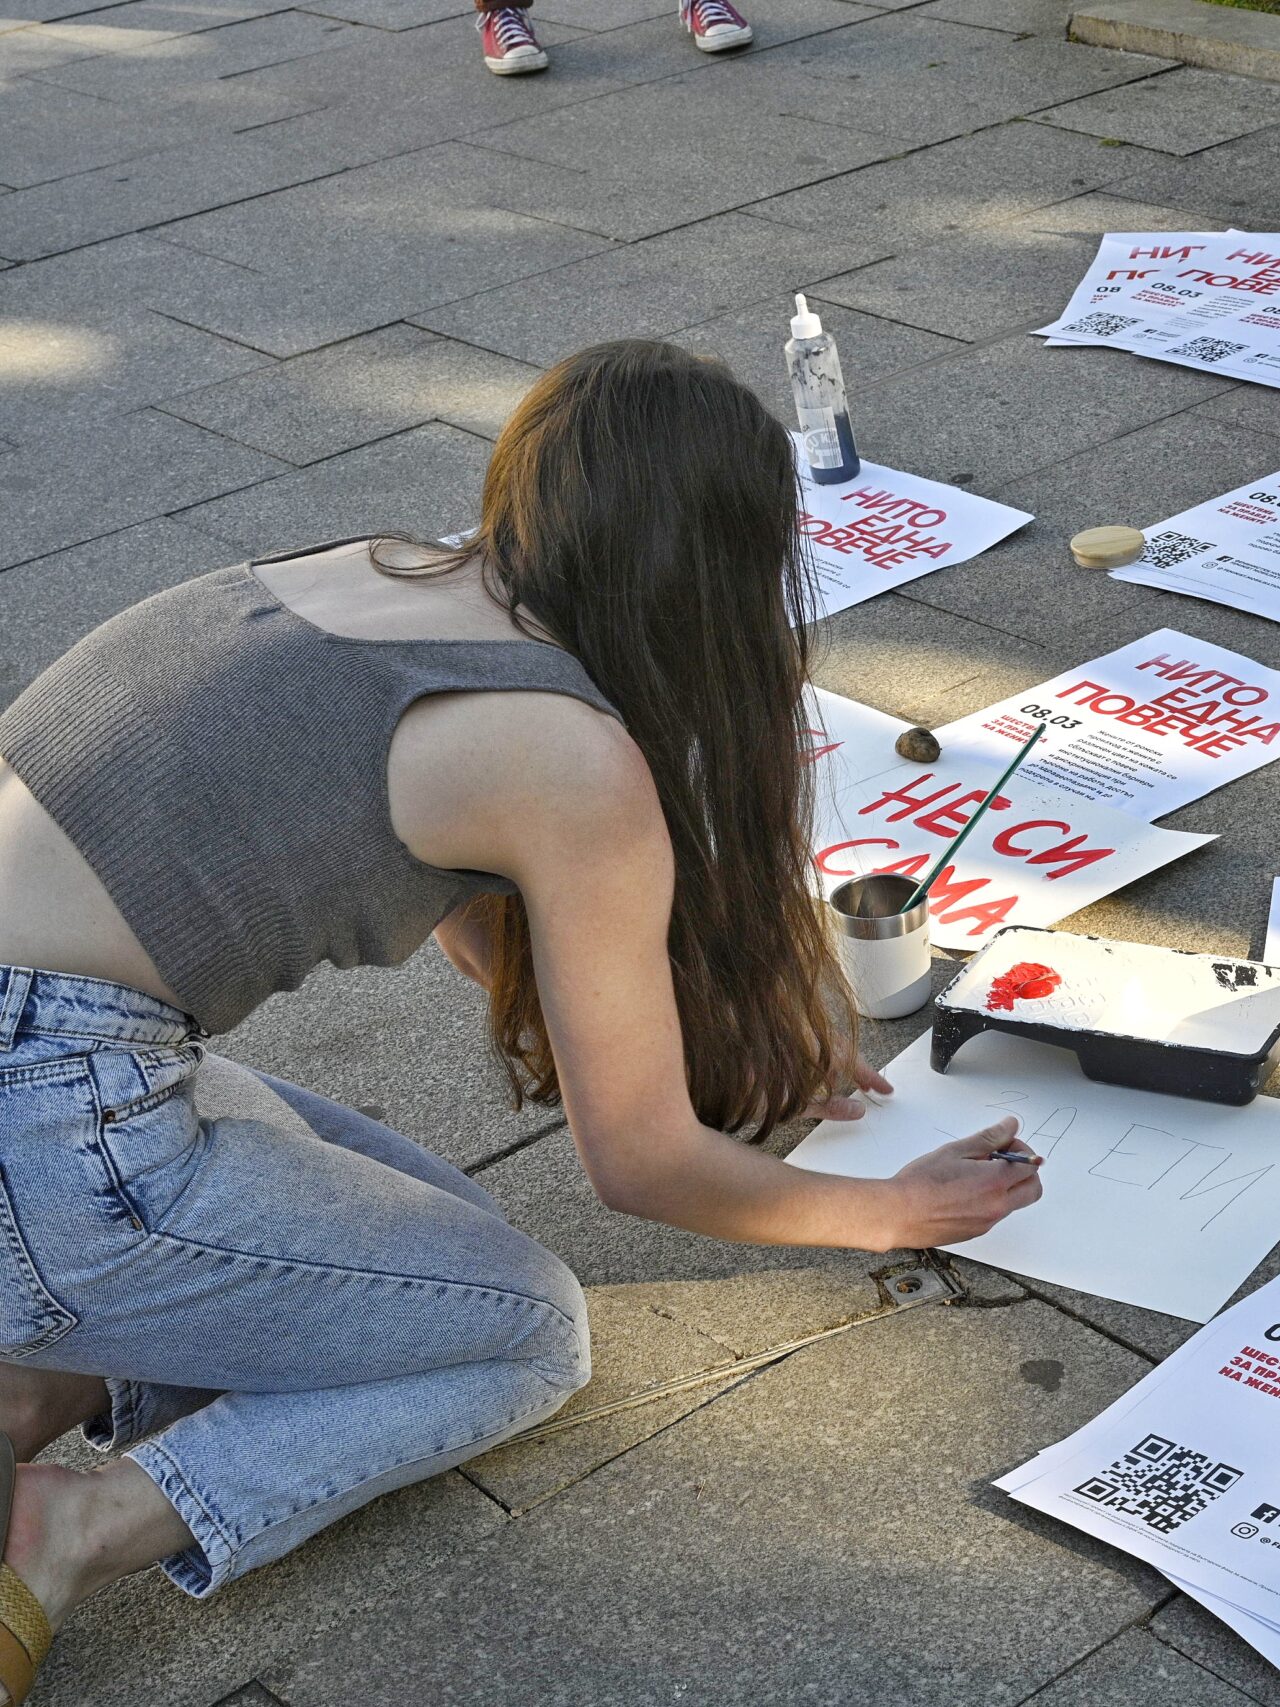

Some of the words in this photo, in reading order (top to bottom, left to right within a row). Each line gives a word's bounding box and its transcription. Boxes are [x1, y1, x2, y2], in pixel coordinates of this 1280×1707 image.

[1151, 282, 1203, 299] 08.03
[840, 485, 947, 528] НИТО
[797, 510, 918, 570] ОВЕЧЕ
[845, 513, 953, 559] ЕДНА
[1135, 653, 1269, 706] НИТО
[1020, 704, 1083, 729] 08.03
[1055, 680, 1248, 758] ПОВЕЧЕ
[858, 773, 1012, 838] НЕ
[992, 819, 1116, 881] СИ
[1218, 1366, 1242, 1381] НА
[1229, 1357, 1255, 1371] ЗА
